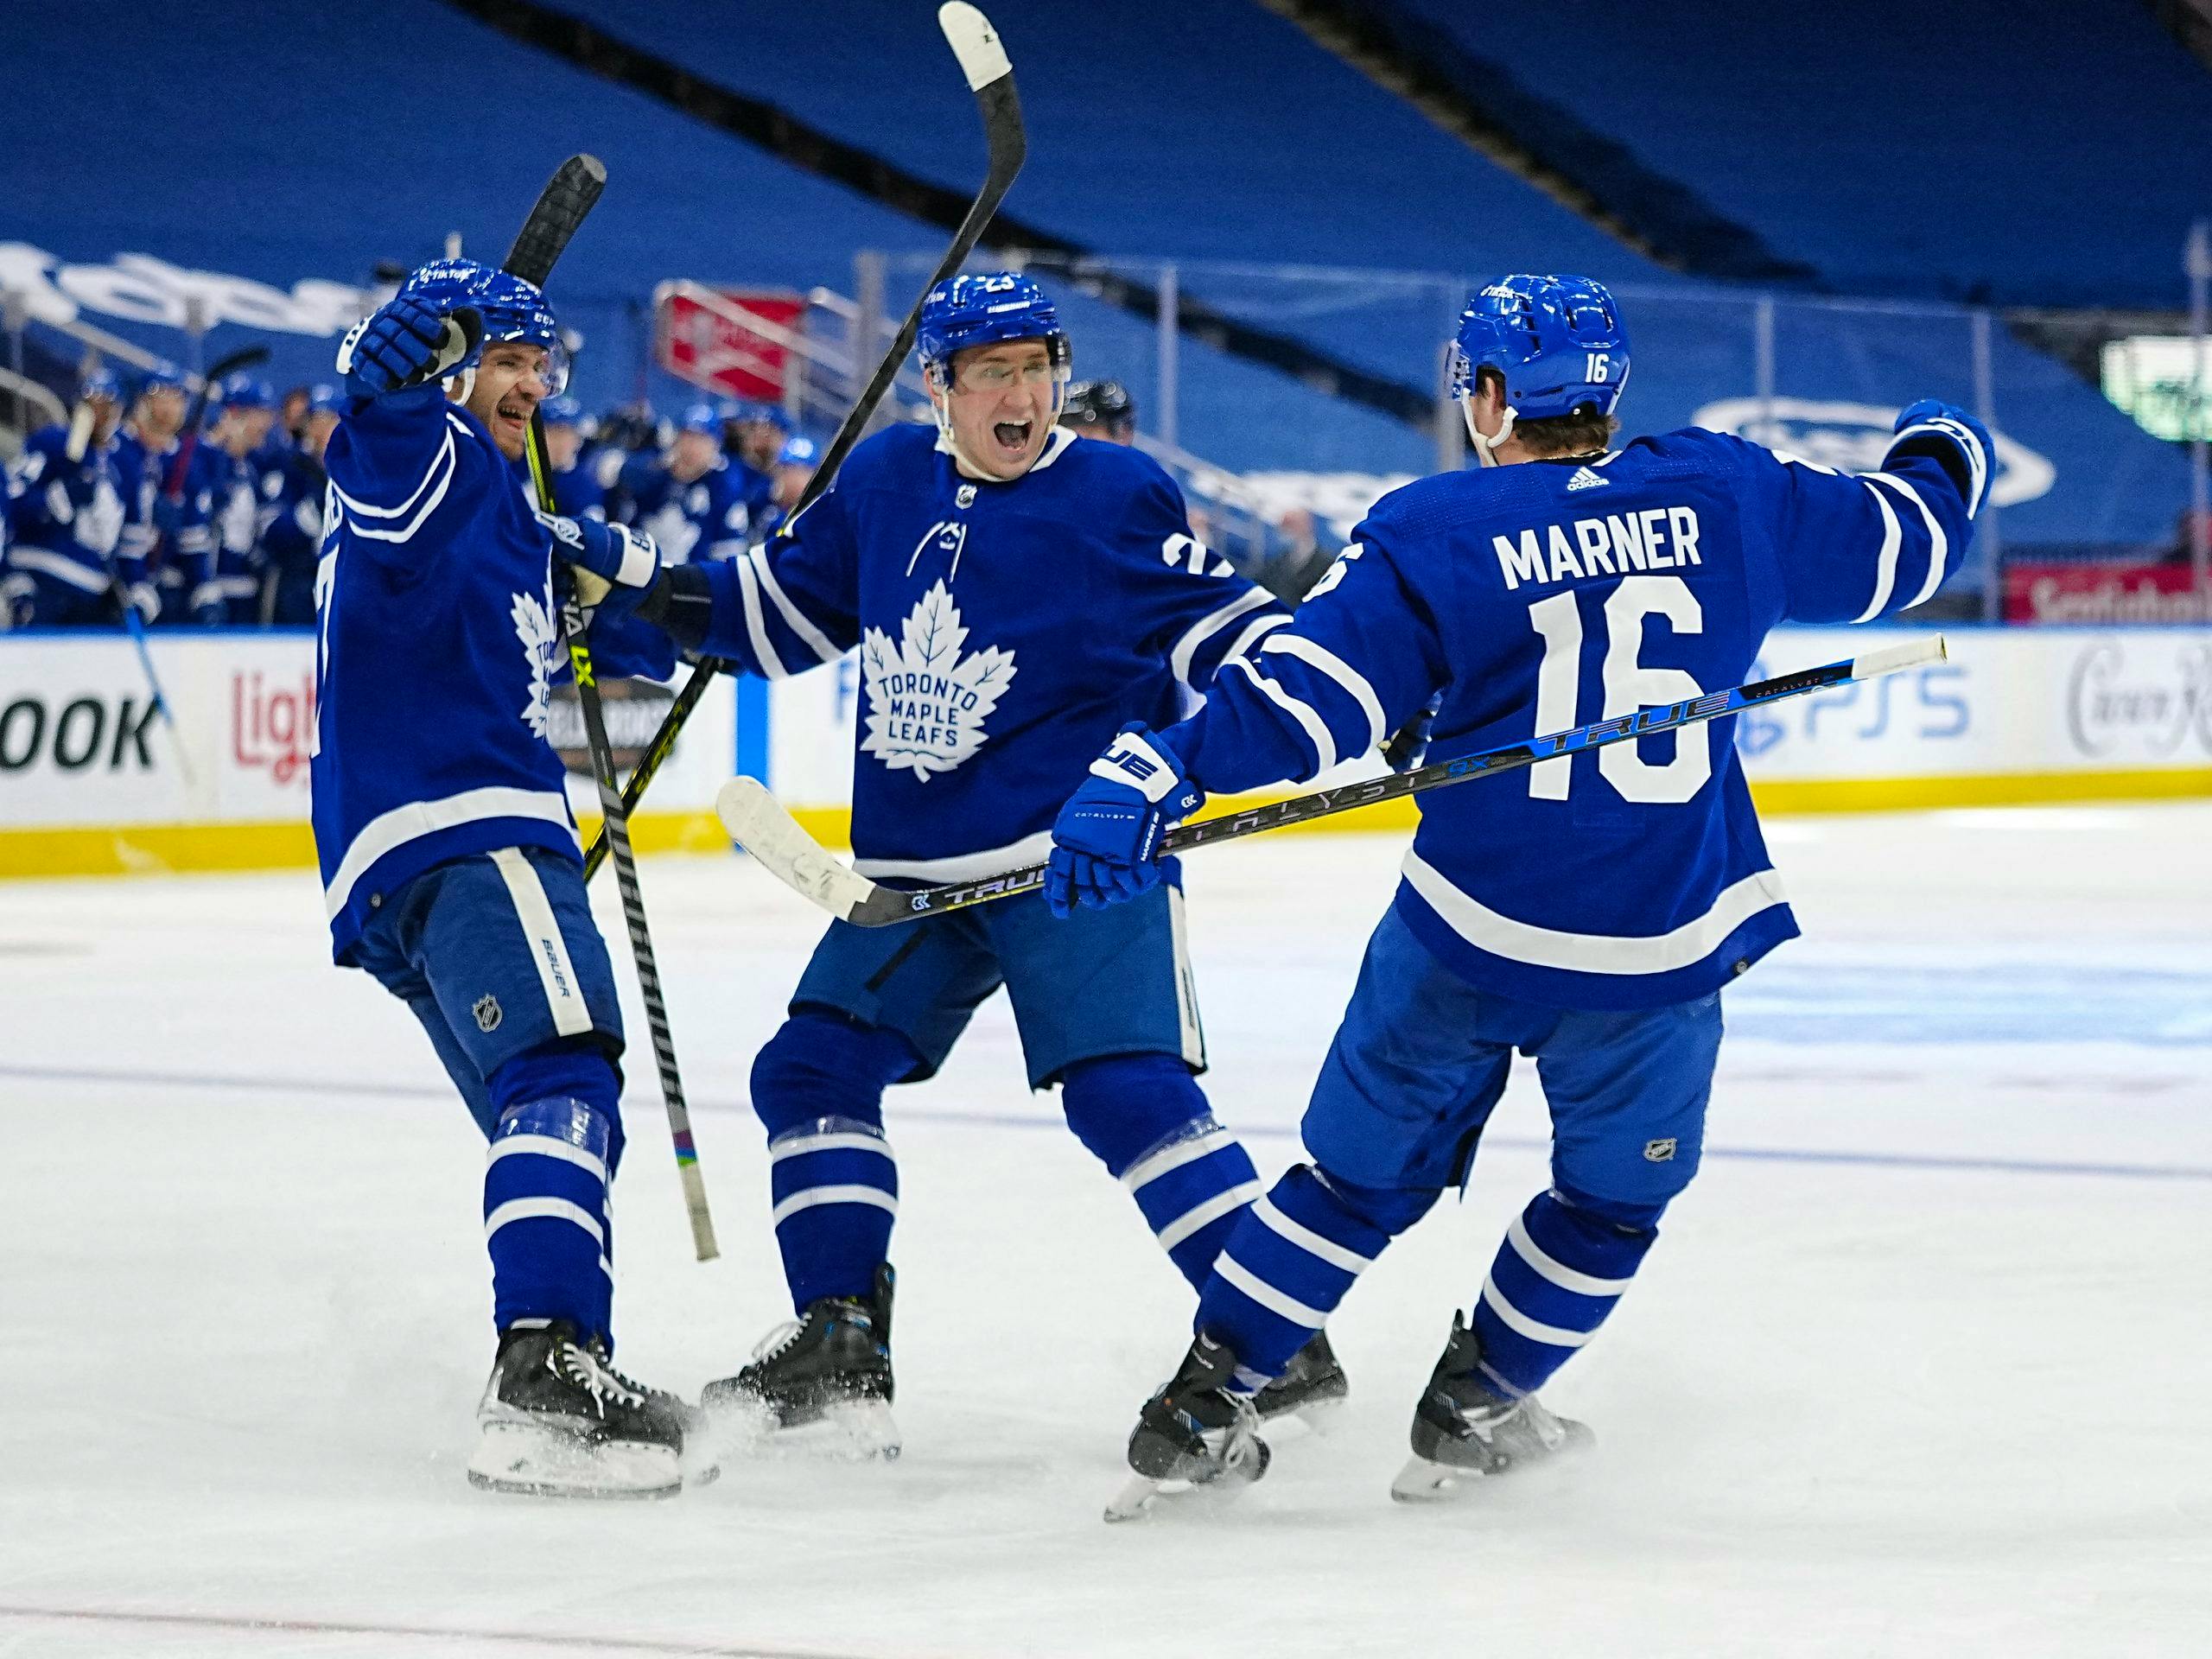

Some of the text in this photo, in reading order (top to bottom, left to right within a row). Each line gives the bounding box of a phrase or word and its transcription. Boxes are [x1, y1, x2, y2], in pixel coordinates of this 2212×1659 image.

[1585, 353, 1610, 383] 16
[1567, 476, 1610, 492] adidas
[1492, 506, 1702, 590] MARNER
[878, 673, 978, 712] TORONTO
[1529, 568, 1712, 804] 16
[890, 698, 959, 725] MAPLE
[1538, 692, 1730, 753] TRUE
[888, 720, 958, 747] LEAFS
[542, 938, 571, 998] BAUER
